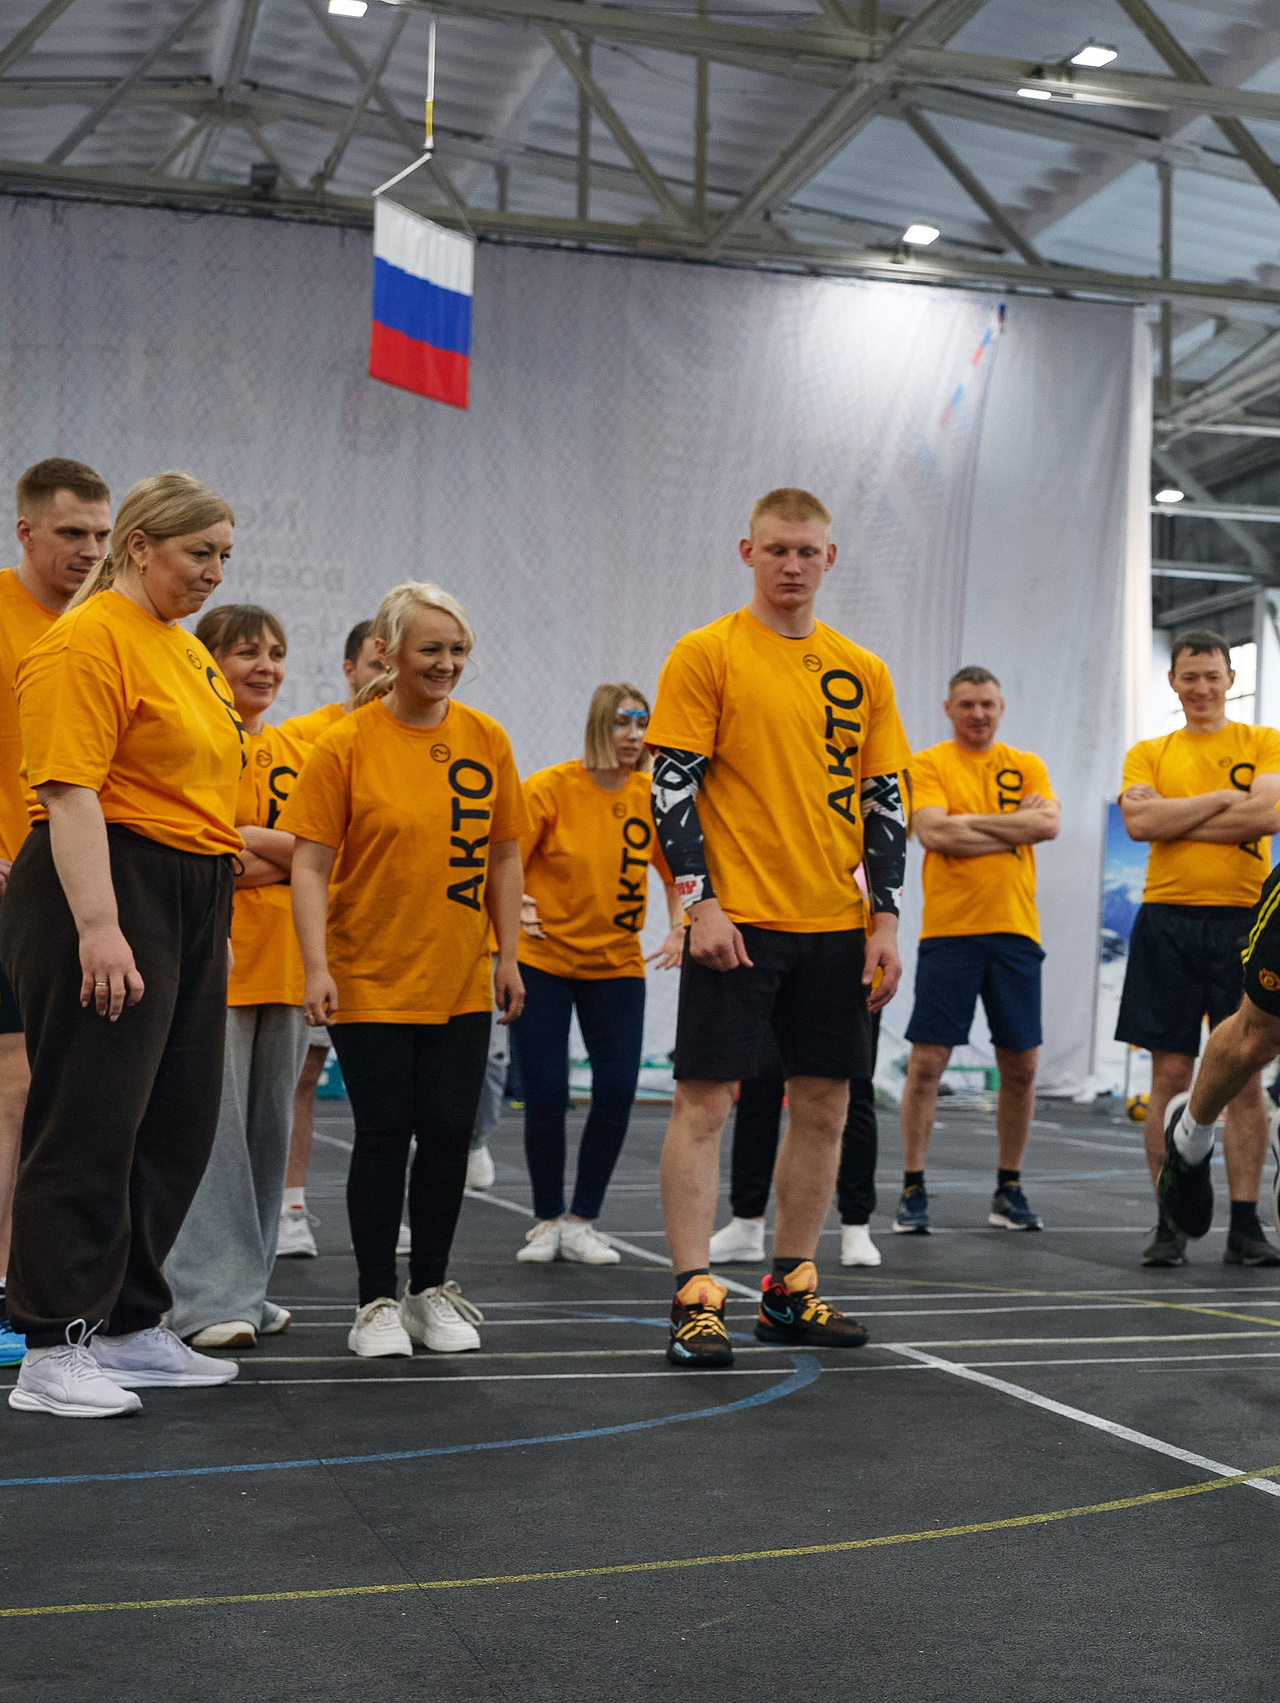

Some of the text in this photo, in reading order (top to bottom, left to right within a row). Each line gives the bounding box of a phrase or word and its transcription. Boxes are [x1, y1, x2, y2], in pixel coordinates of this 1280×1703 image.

[821, 669, 863, 825] АКТО
[447, 758, 493, 912] АКТО
[612, 817, 651, 933] АКТО
